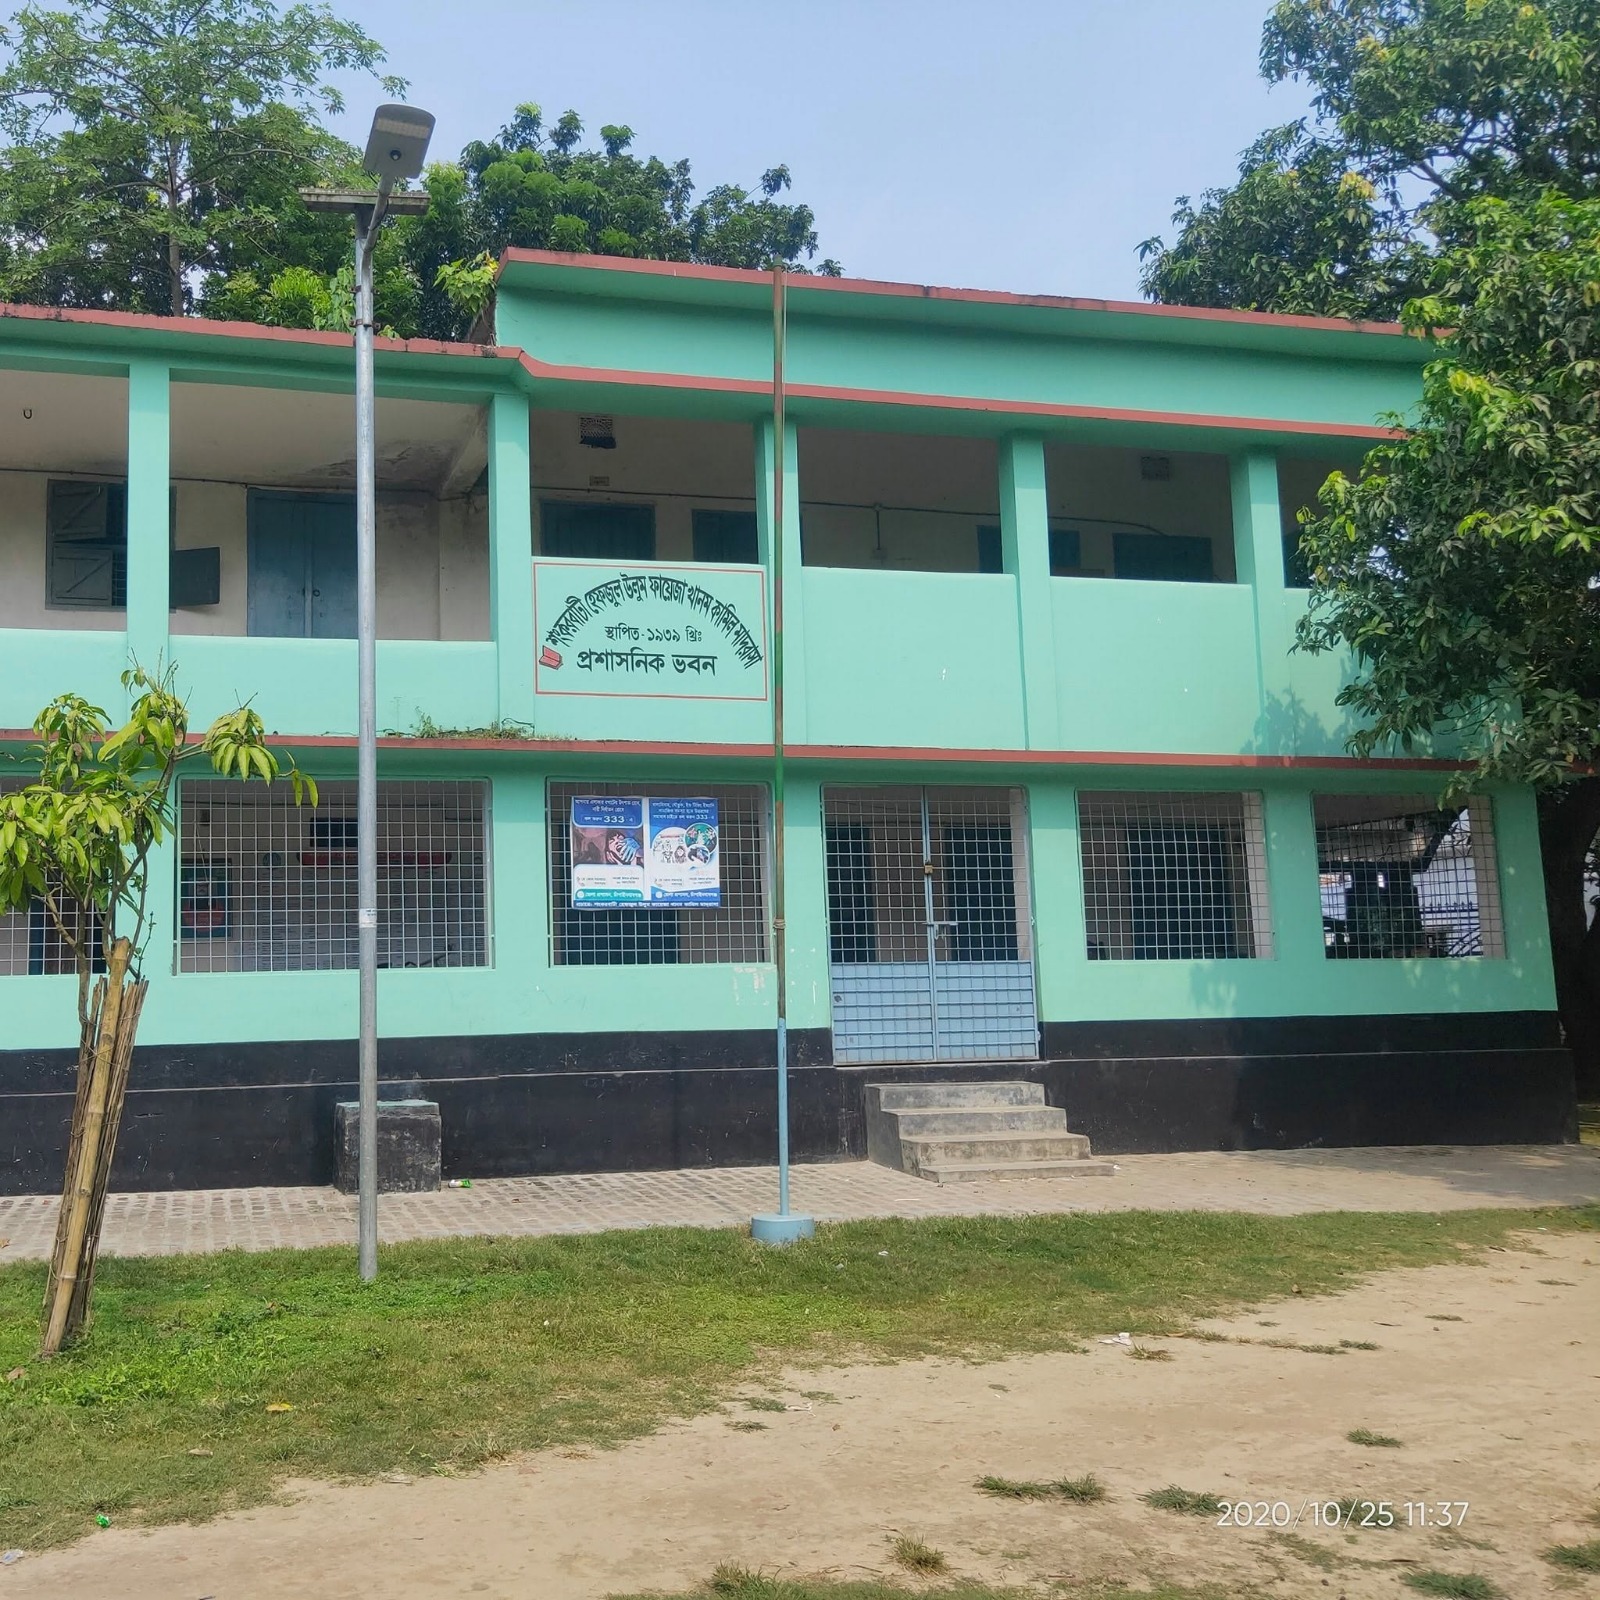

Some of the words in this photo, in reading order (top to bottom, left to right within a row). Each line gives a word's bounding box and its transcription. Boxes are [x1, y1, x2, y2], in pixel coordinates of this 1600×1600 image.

[584, 578, 625, 615] হেফজুল
[619, 572, 648, 602] উলুম
[647, 574, 689, 605] ফায়েজা
[686, 584, 714, 619] খানম
[710, 599, 741, 639] কামিল
[646, 627, 681, 643] ১৯৩৯
[576, 646, 666, 674] প্রশাসনিক
[671, 654, 719, 676] ভবন
[603, 815, 625, 823] 333
